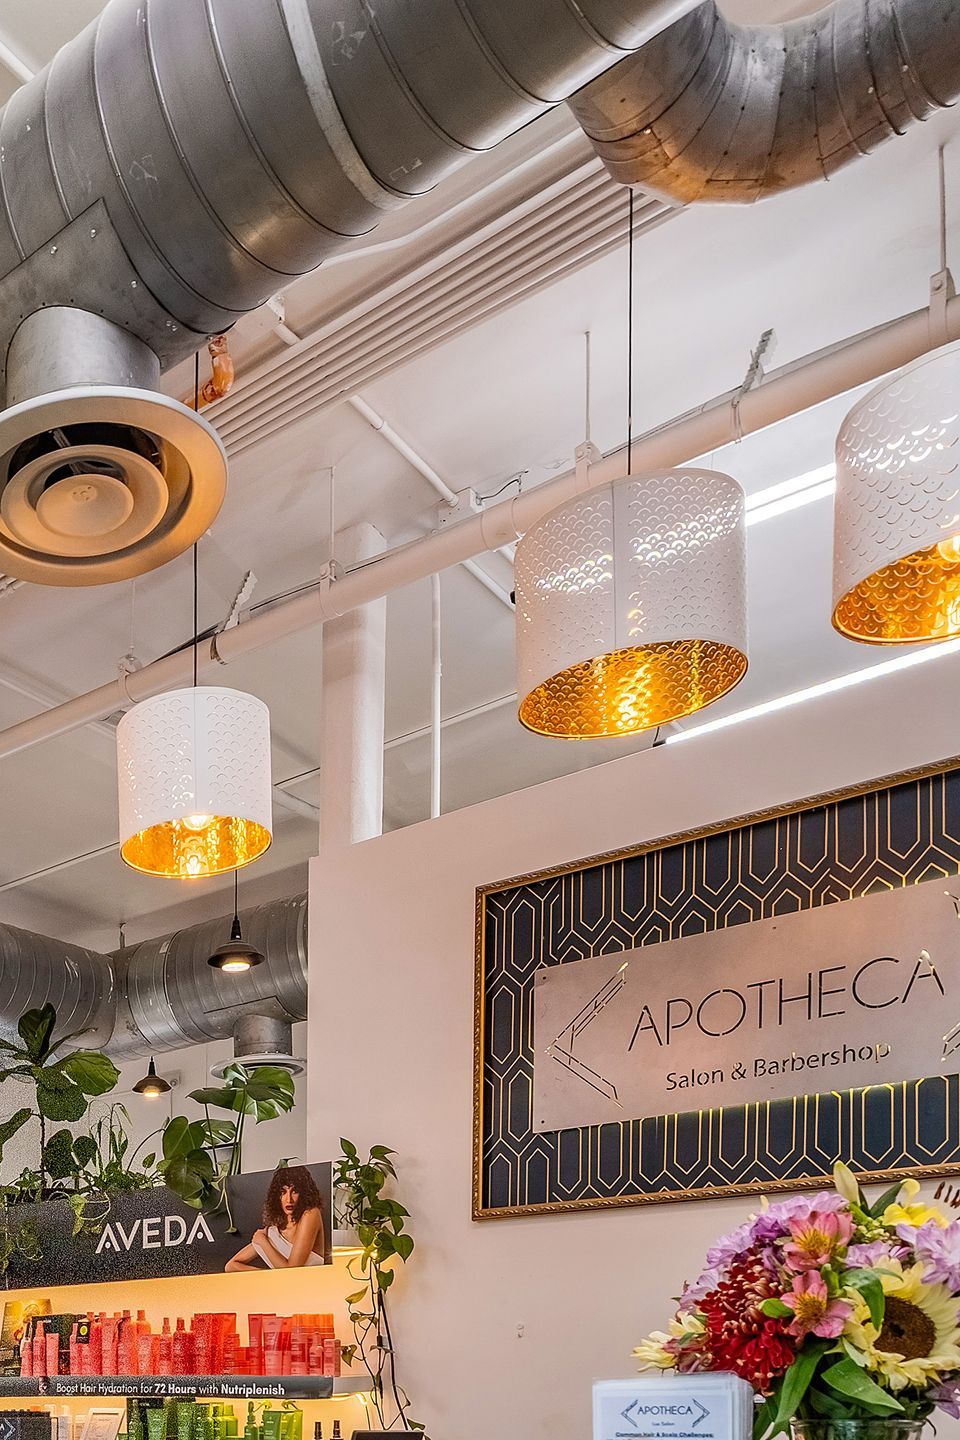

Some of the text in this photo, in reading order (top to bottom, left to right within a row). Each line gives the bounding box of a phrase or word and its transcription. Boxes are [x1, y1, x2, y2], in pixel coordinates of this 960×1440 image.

[627, 948, 945, 1052] APOTHECA
[665, 1043, 892, 1091] Salon & Barbershop
[95, 1211, 215, 1254] AVEDA
[56, 1382, 285, 1398] Boost Hair Hydration for 72 Hours with Nutriplenish
[637, 1405, 694, 1415] APOTHECA
